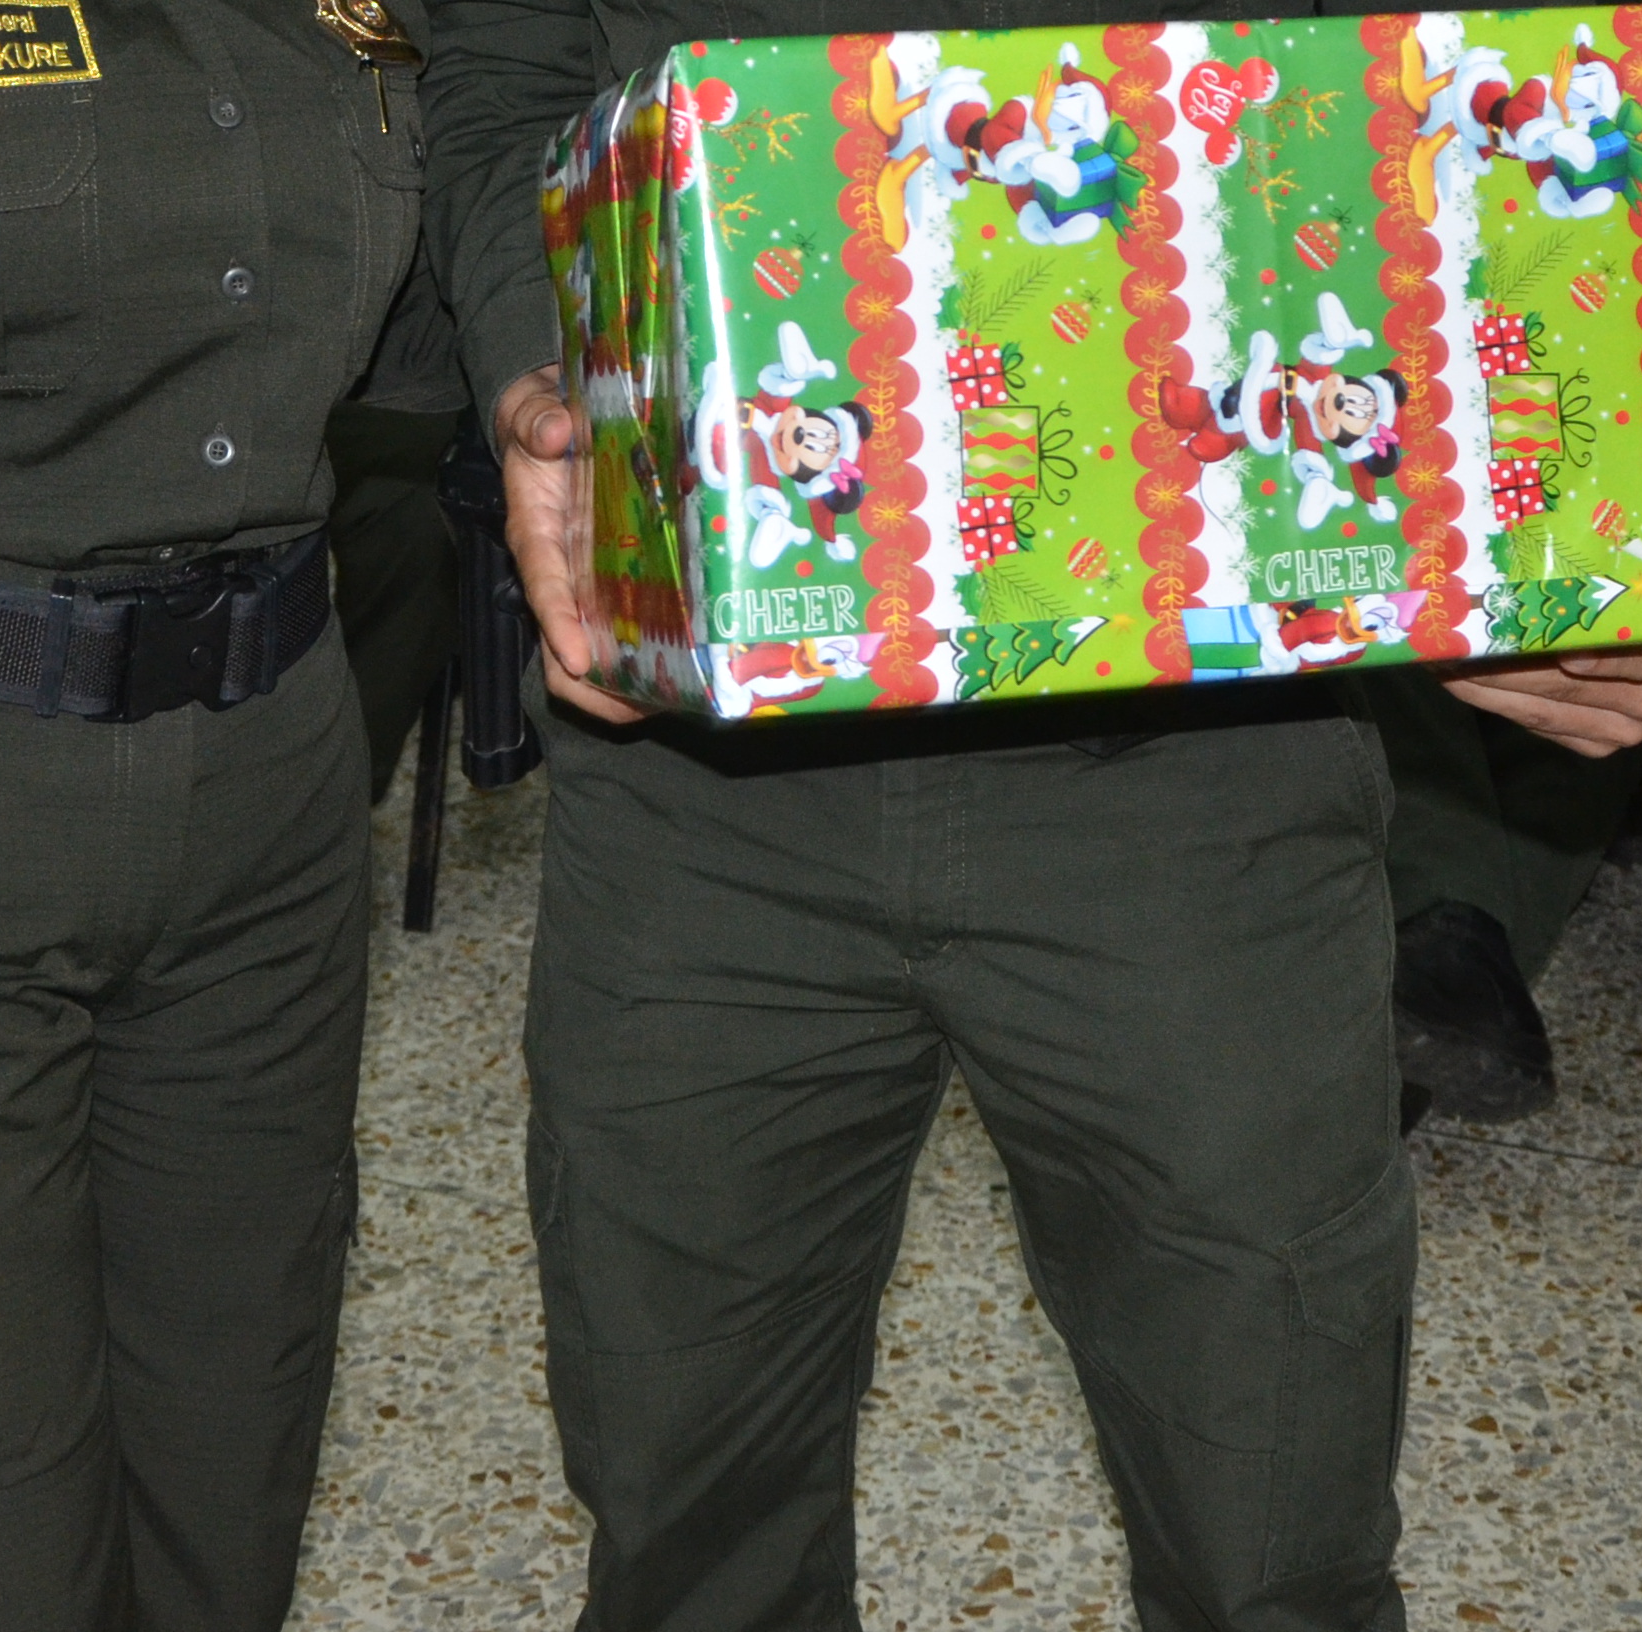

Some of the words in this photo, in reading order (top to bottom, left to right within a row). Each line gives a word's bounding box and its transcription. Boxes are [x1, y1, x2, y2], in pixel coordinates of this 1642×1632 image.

[1188, 67, 1246, 126] Joy
[1263, 544, 1401, 598] CHEER
[713, 584, 860, 639] CHEER
